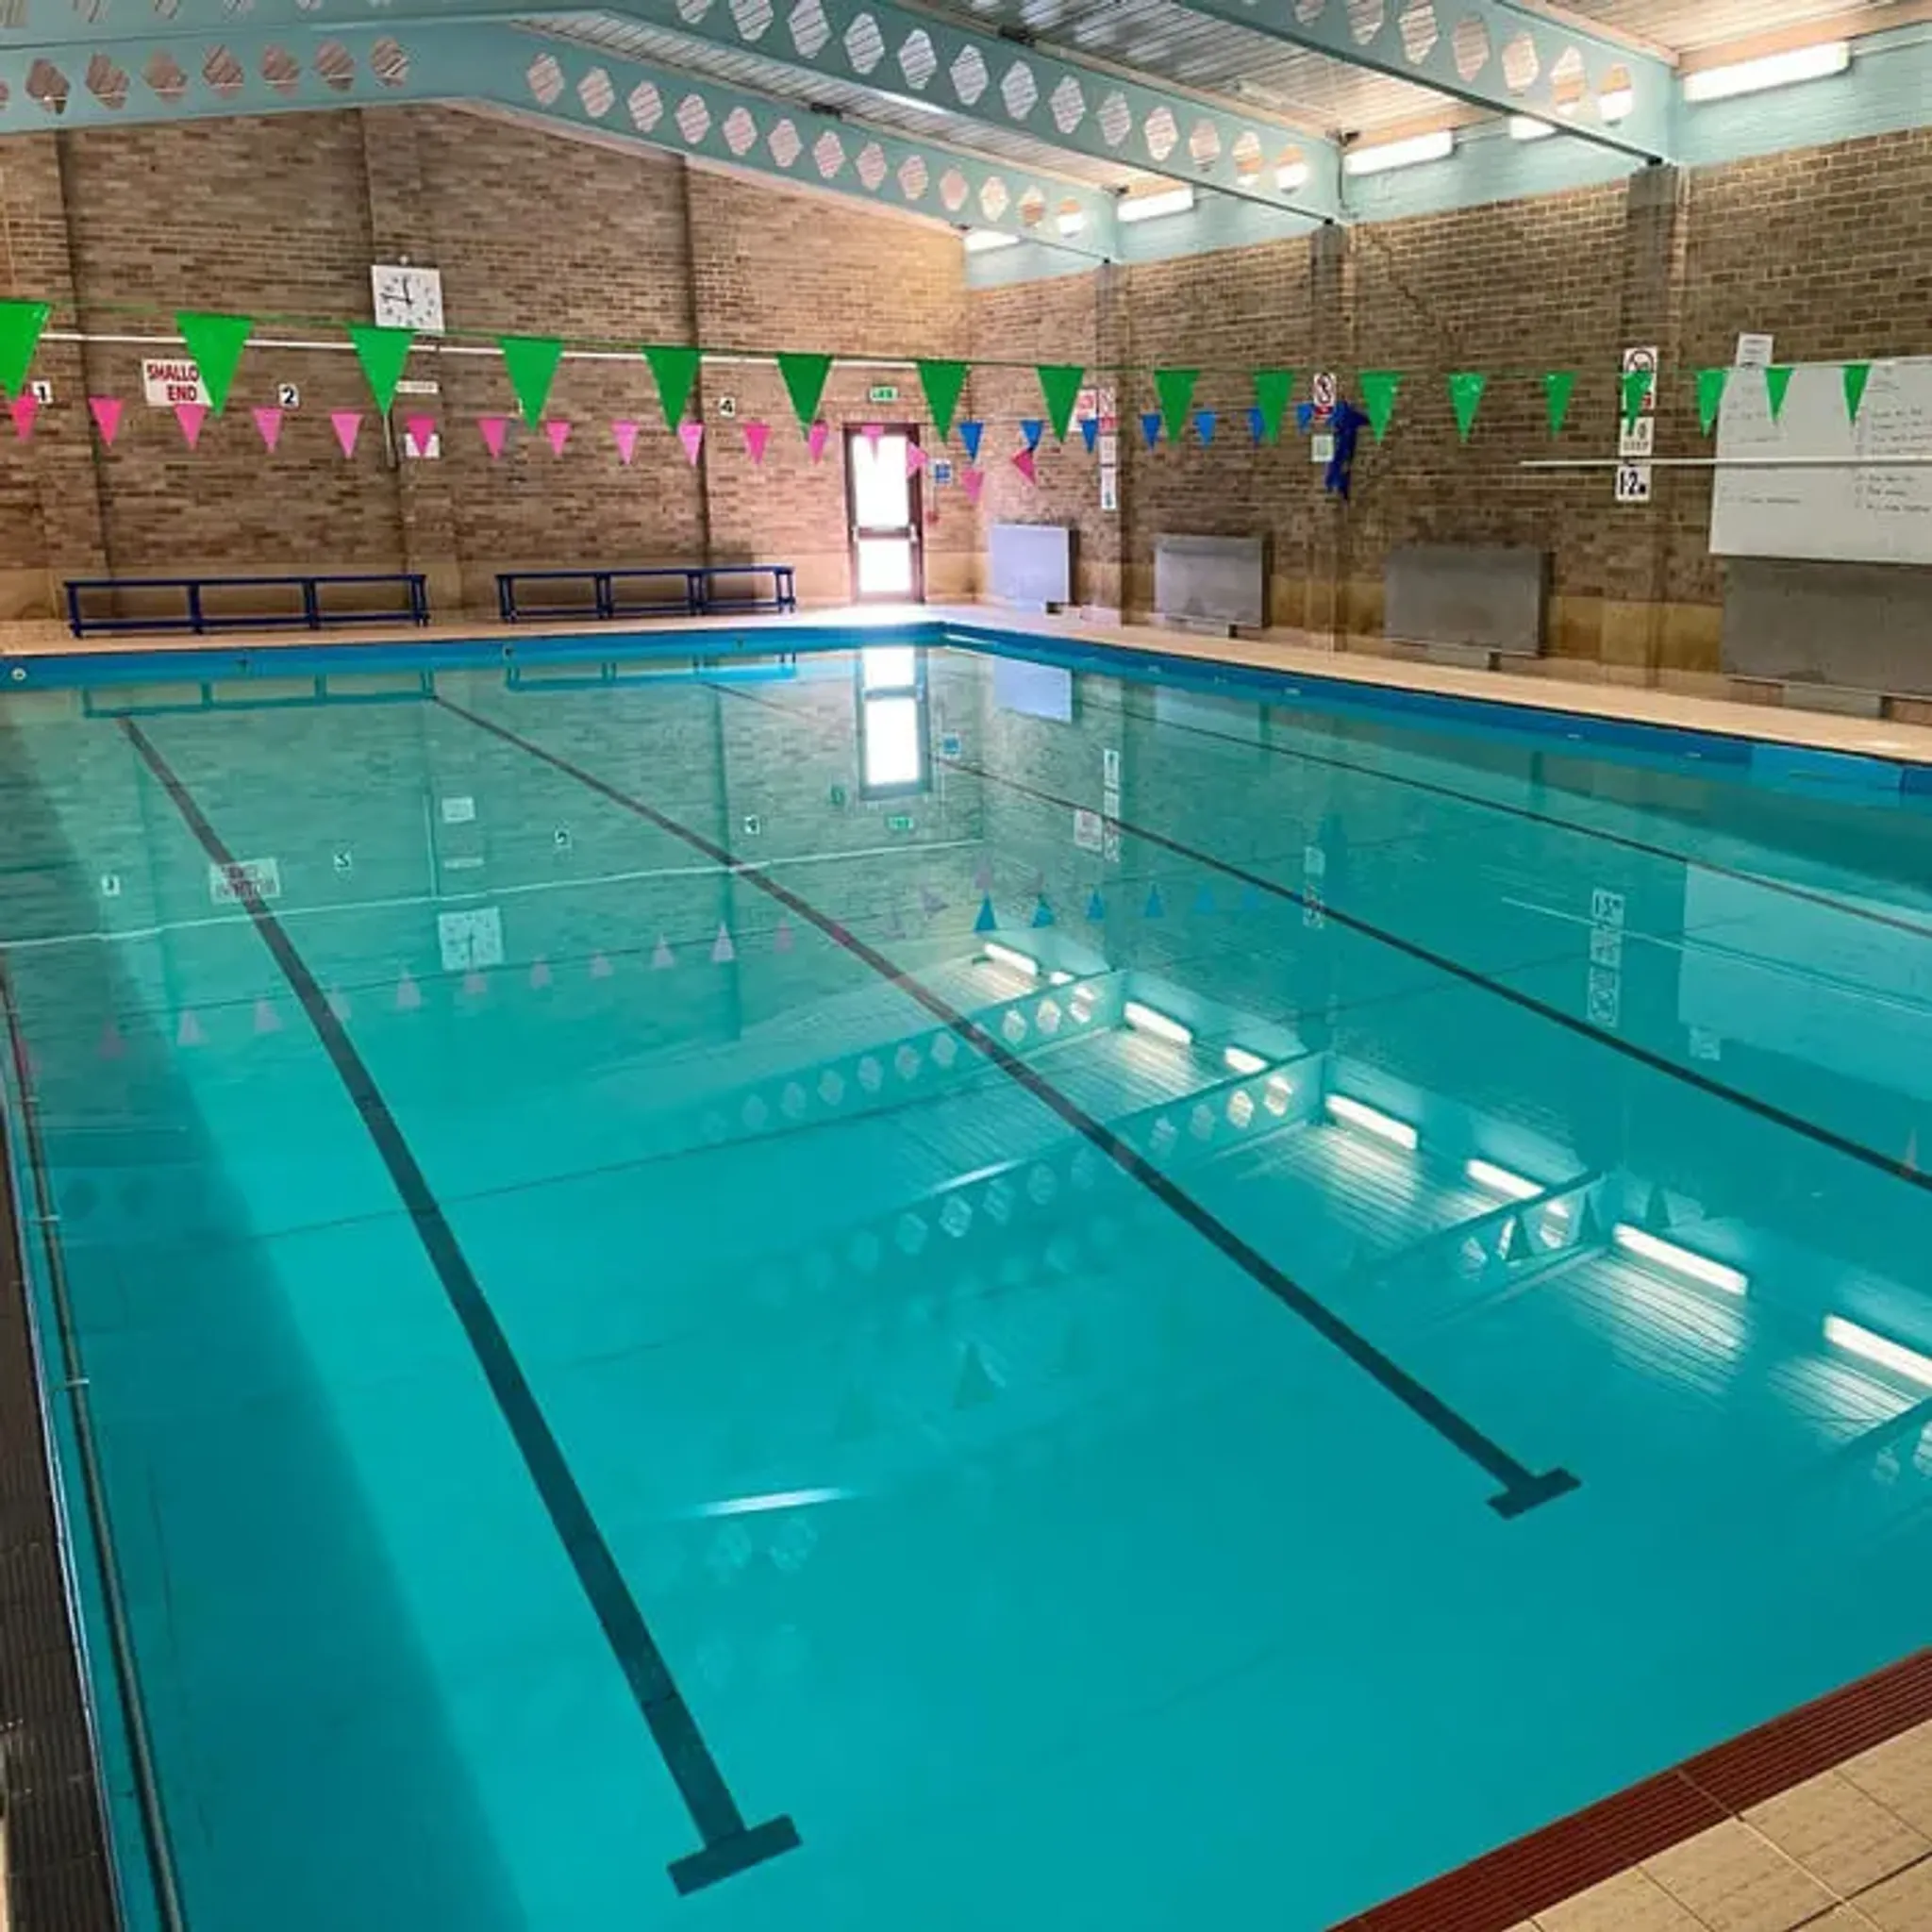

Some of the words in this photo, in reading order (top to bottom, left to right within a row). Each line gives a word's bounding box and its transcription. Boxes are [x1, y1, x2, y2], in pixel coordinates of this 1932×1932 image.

[146, 364, 200, 382] SHALLO
[166, 384, 197, 402] END
[282, 386, 294, 405] 2
